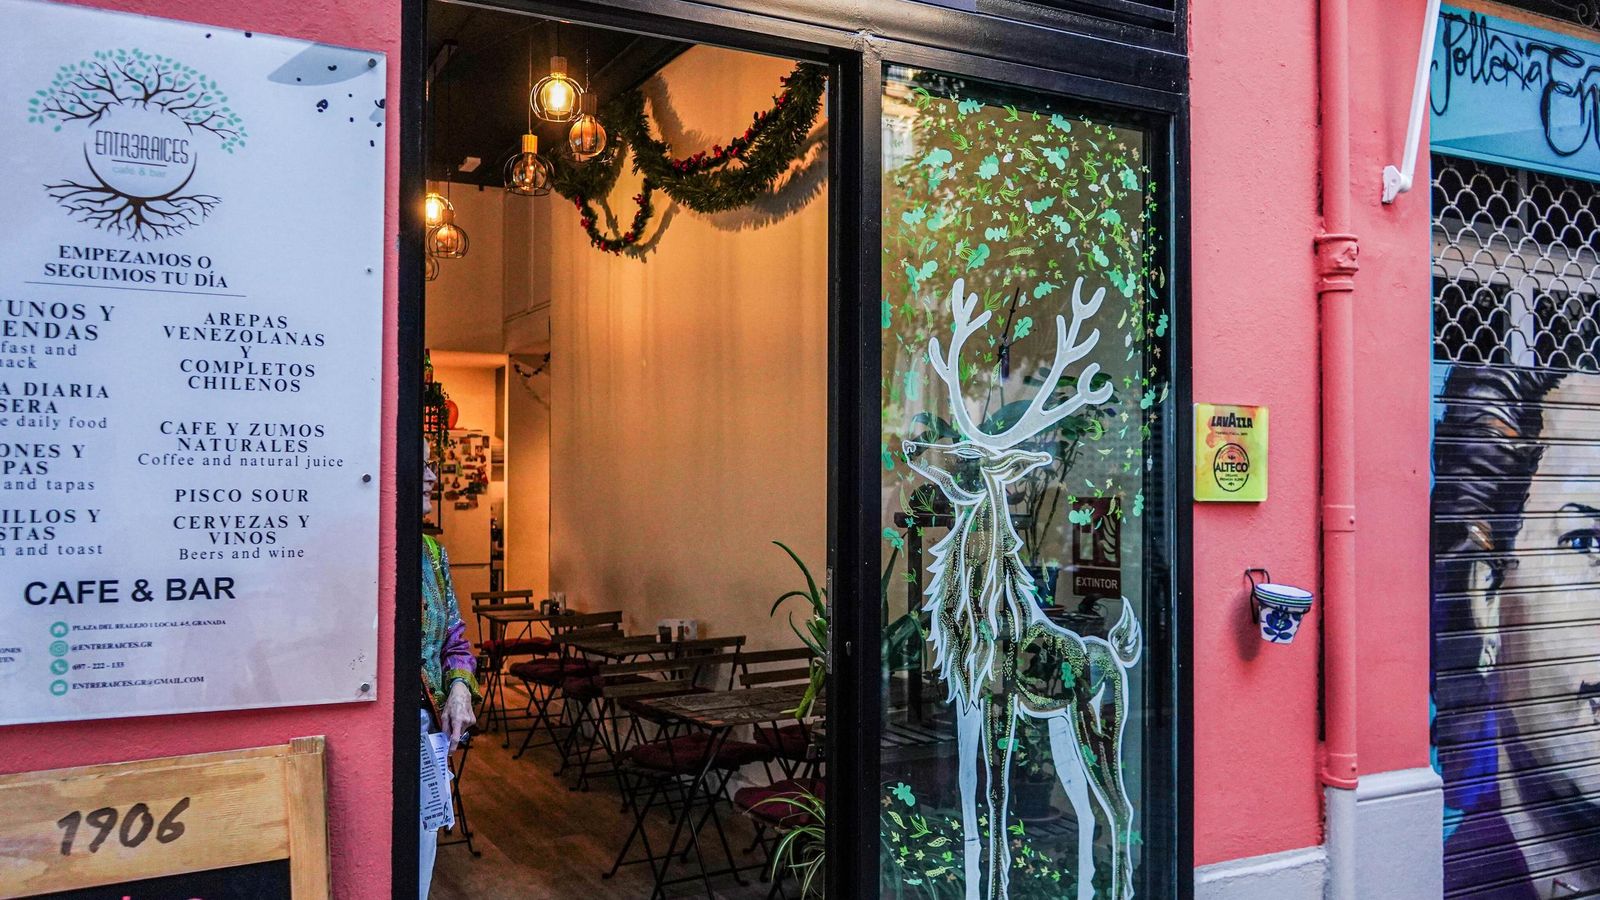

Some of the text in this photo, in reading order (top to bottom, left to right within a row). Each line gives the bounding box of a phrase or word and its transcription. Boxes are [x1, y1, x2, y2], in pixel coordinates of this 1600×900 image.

[60, 246, 211, 269] EMPEZAMOS O
[44, 262, 227, 288] SEGUIMOS TU DÍA
[0, 300, 114, 321] UNOS Y
[204, 313, 287, 329] AREPAS
[164, 326, 324, 346] VENEZOLANAS
[45, 344, 76, 356] and
[240, 346, 251, 358] Y
[0, 356, 37, 368] ack
[180, 359, 314, 377] COMPLETOS
[24, 382, 108, 398] DIARIA
[188, 376, 300, 392] CHILENOS
[17, 415, 58, 430] daily
[69, 416, 107, 428] food
[1211, 412, 1253, 428] LAVAZZA
[160, 421, 324, 437] CAFE Y ZUMOS
[72, 445, 84, 458] Y
[178, 438, 307, 452] NATURALES
[138, 453, 343, 469] Coffee and natural juice
[1215, 462, 1248, 472] ALTECO
[4, 478, 94, 493] and tapas
[176, 489, 308, 502] PISCO SOUR
[88, 510, 100, 522] Y
[173, 515, 309, 529] CERVEZAS Y
[209, 531, 275, 544] VINOS
[16, 543, 48, 555] and
[58, 545, 102, 555] toast
[180, 547, 304, 560] Beers and wine
[24, 577, 235, 605] CAFE & BAR
[1076, 577, 1118, 590] EXTINTOR
[191, 619, 226, 627] GRANADA
[56, 796, 191, 856] 1906
